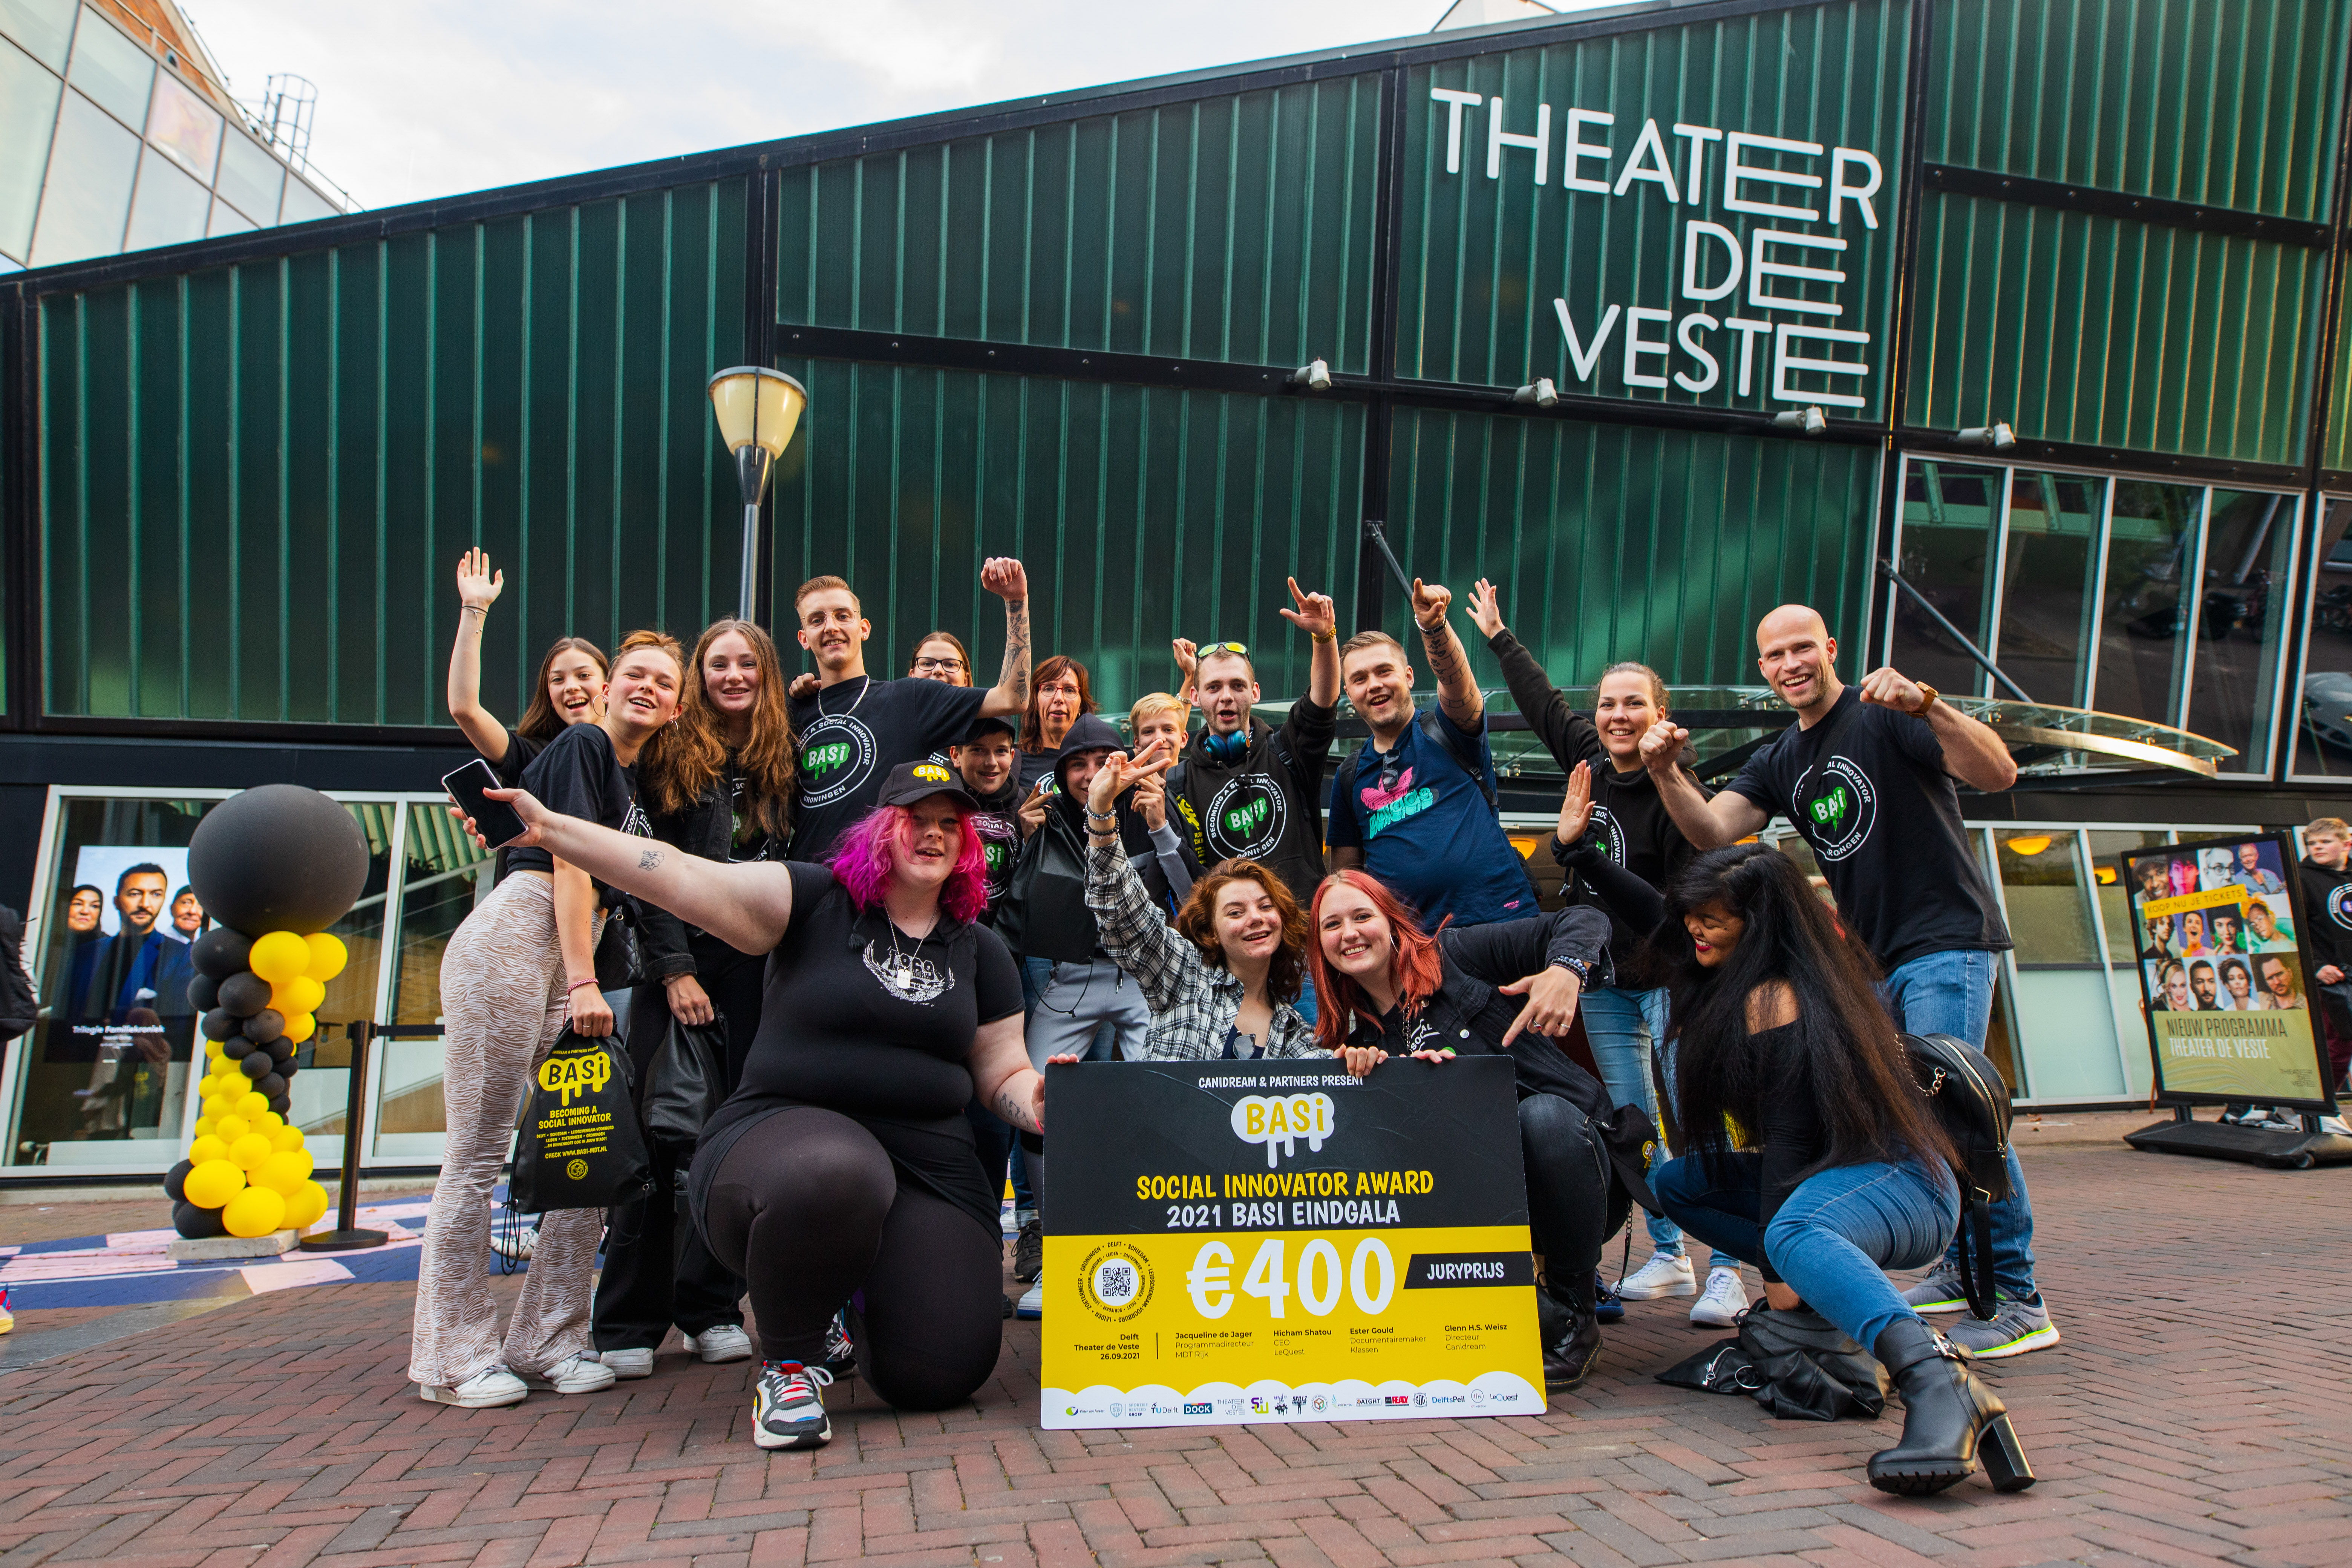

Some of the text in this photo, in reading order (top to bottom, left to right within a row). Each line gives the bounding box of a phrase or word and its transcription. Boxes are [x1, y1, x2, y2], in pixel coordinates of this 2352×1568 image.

[1431, 88, 1882, 229] THEATER
[1682, 220, 1847, 315] DE
[1554, 298, 1870, 407] VESTE
[849, 722, 871, 765] INNOVATOR
[1837, 762, 1871, 803] INNOVATOR
[804, 785, 846, 803] GRONINGEN
[1210, 796, 1223, 838] BECOMING
[1256, 778, 1282, 812] INNOVATOR
[1610, 825, 1620, 865] INNOVAT
[2148, 889, 2243, 913] KOOP NU JE TICKETS
[2166, 1018, 2288, 1037] NIEUW PROGRAMMA
[2168, 1038, 2271, 1058] THEATER DE VESTE
[1199, 1075, 1363, 1088] CANIDREAM & PARTNERS PRESENT
[539, 1113, 611, 1129] SOCIAL INNOVATOR
[550, 1106, 597, 1119] BECOMING A
[562, 1146, 607, 1156] WWW.BASI-MDT.NL
[1137, 1170, 1433, 1199] SOCIAL INNOVATOR AWARD
[1167, 1200, 1400, 1228] 2021 BASI EINDGALA
[1080, 1246, 1101, 1271] GRONINGEN
[1123, 1253, 1142, 1271] ZOETERMEER
[1127, 1244, 1149, 1263] SCHIEDAM
[1186, 1237, 1395, 1319] €400
[1427, 1262, 1504, 1280] JURYPRIJS
[1078, 1278, 1092, 1310] ZOETERMEER
[1118, 1268, 1155, 1323] LEIDSCHENDAM-VOORBURG
[1127, 1301, 1137, 1310] DELFT
[1095, 1312, 1112, 1322] LEIDEN
[1231, 1331, 1252, 1339] Jager
[1351, 1336, 1426, 1344] Documentairemaker
[1176, 1341, 1254, 1350] Programmadirecteur
[1195, 1351, 1209, 1359] Rijk
[1274, 1348, 1305, 1356] LeQuest
[1185, 1405, 1210, 1413] DOCK
